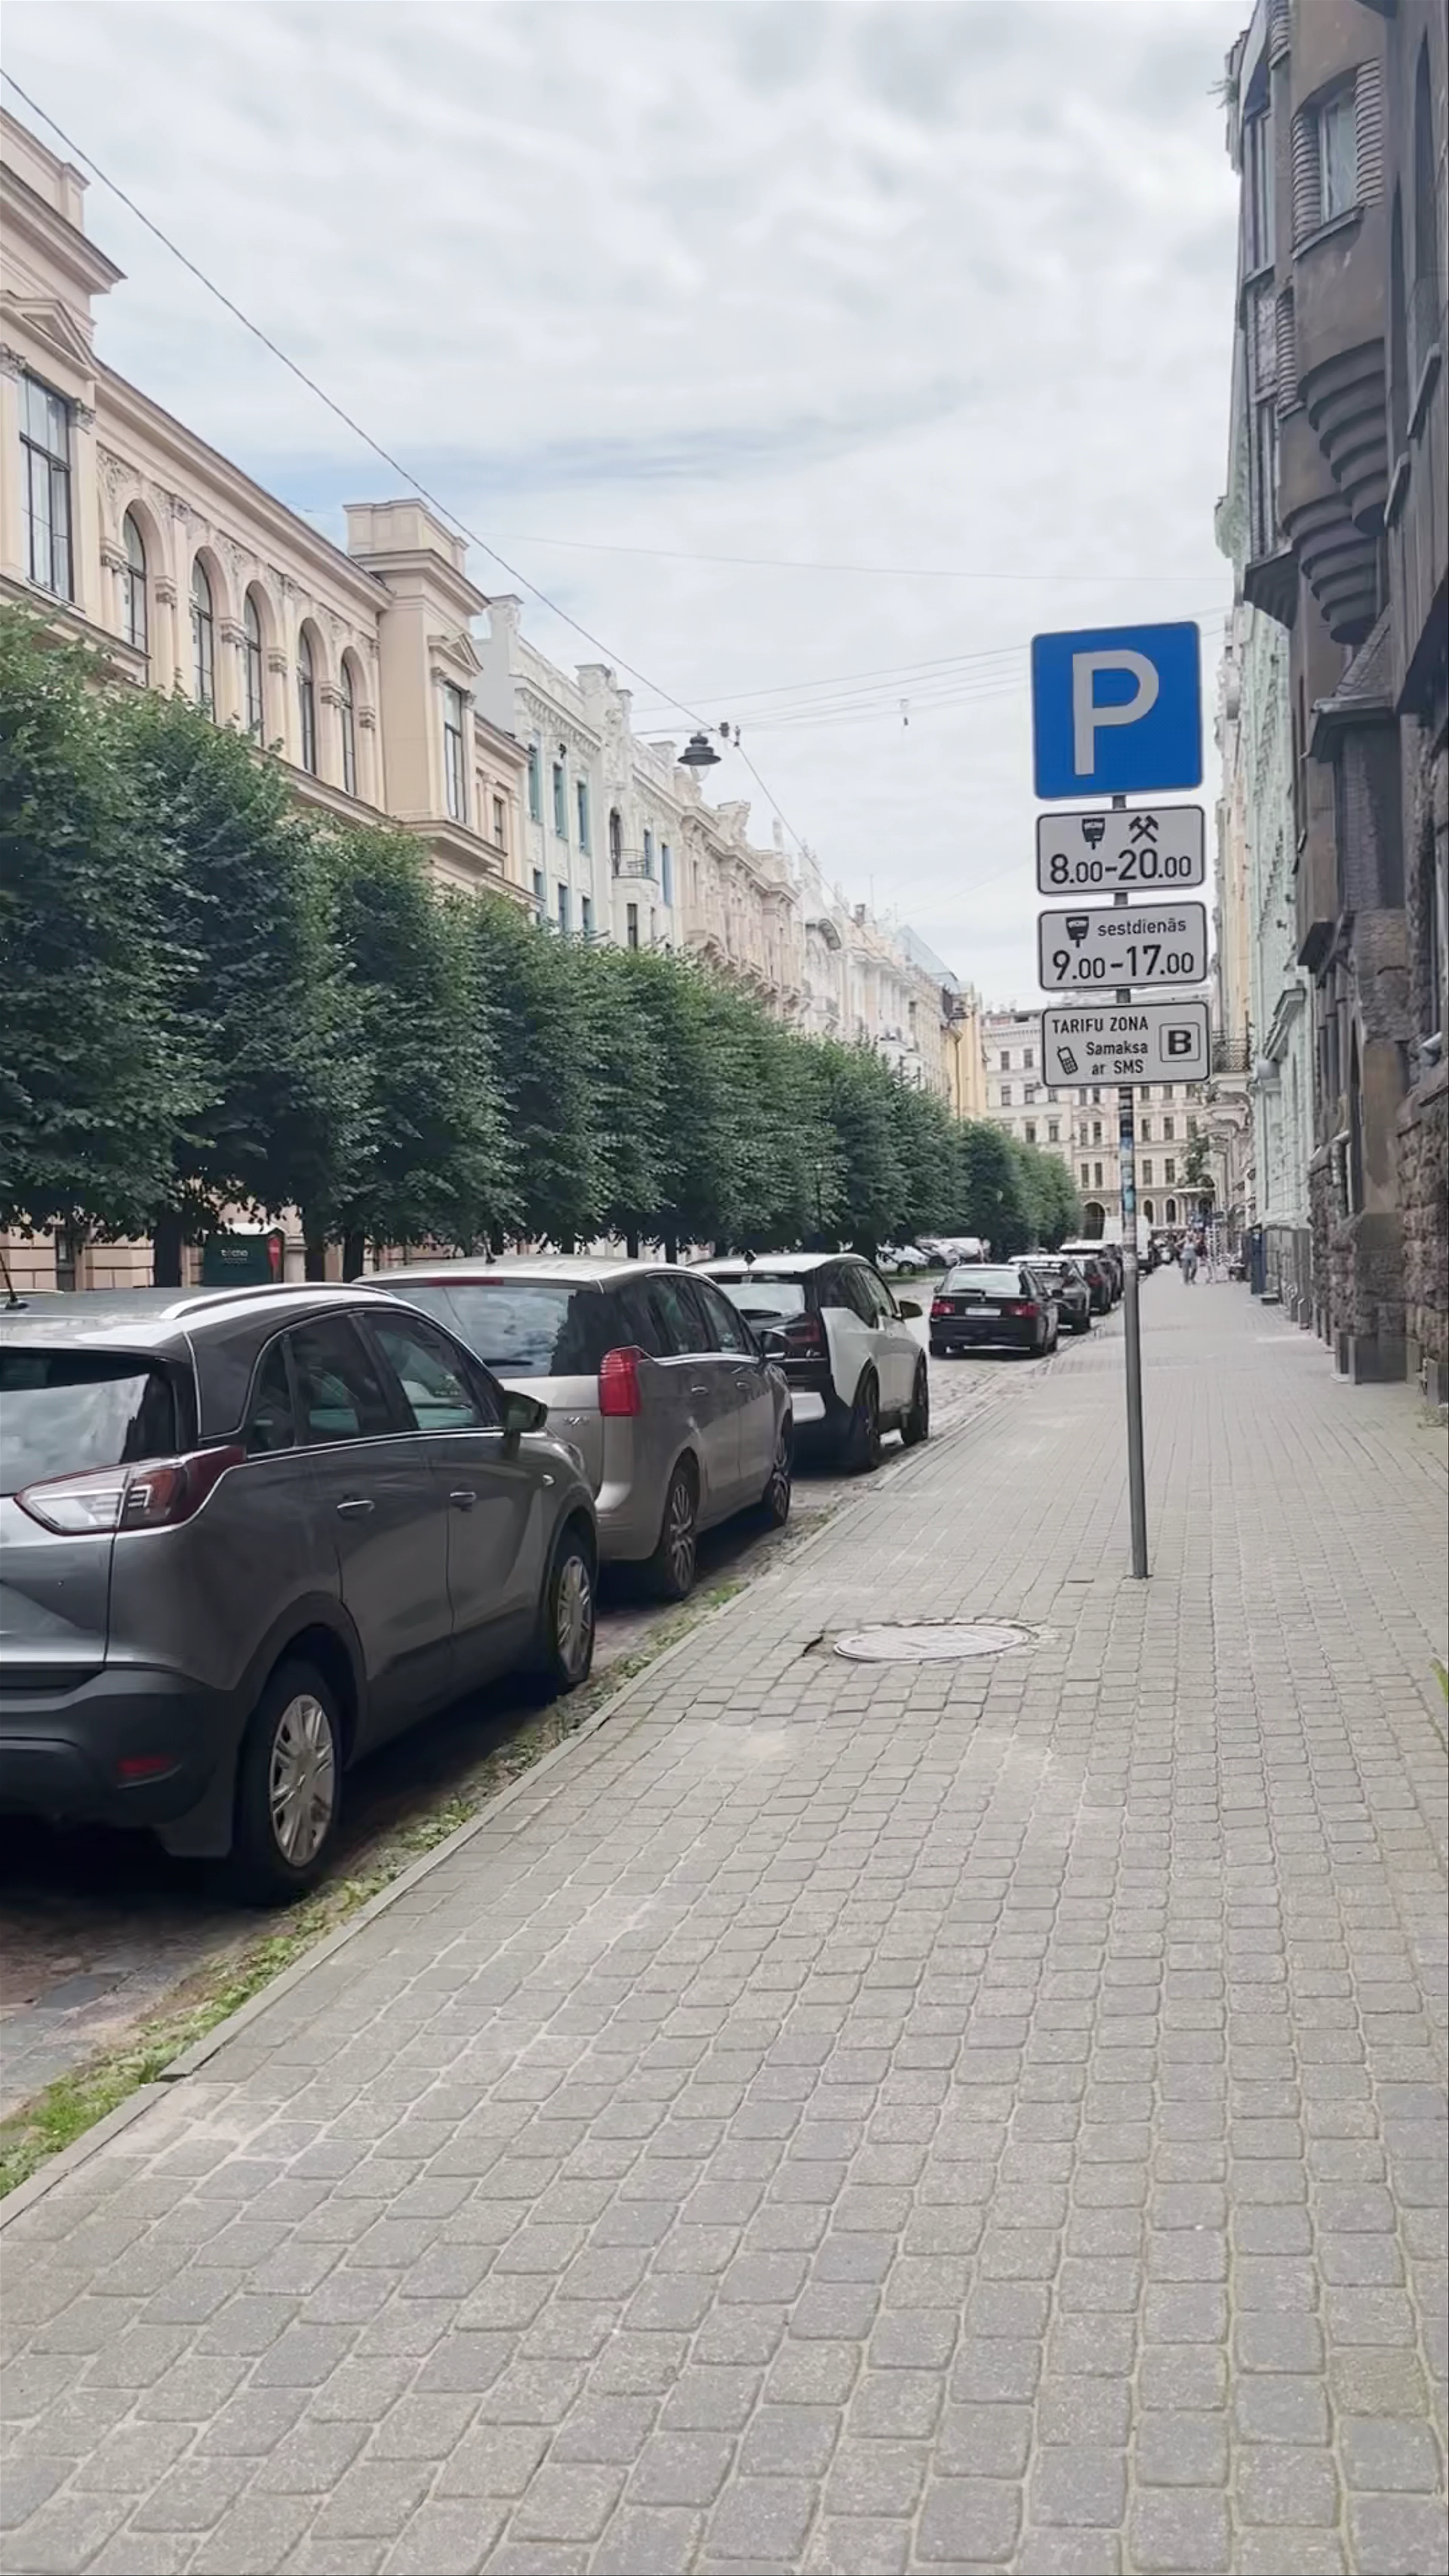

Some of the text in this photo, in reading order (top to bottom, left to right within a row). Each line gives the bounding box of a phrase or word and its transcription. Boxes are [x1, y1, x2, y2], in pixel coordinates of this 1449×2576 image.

[1072, 649, 1159, 776] P
[1097, 917, 1186, 937] sestdienās
[1052, 1016, 1149, 1034] TARIFU ZONA
[1086, 1040, 1148, 1055] Samaksa
[1168, 1030, 1192, 1055] B
[1092, 1059, 1143, 1075] ar SMS
